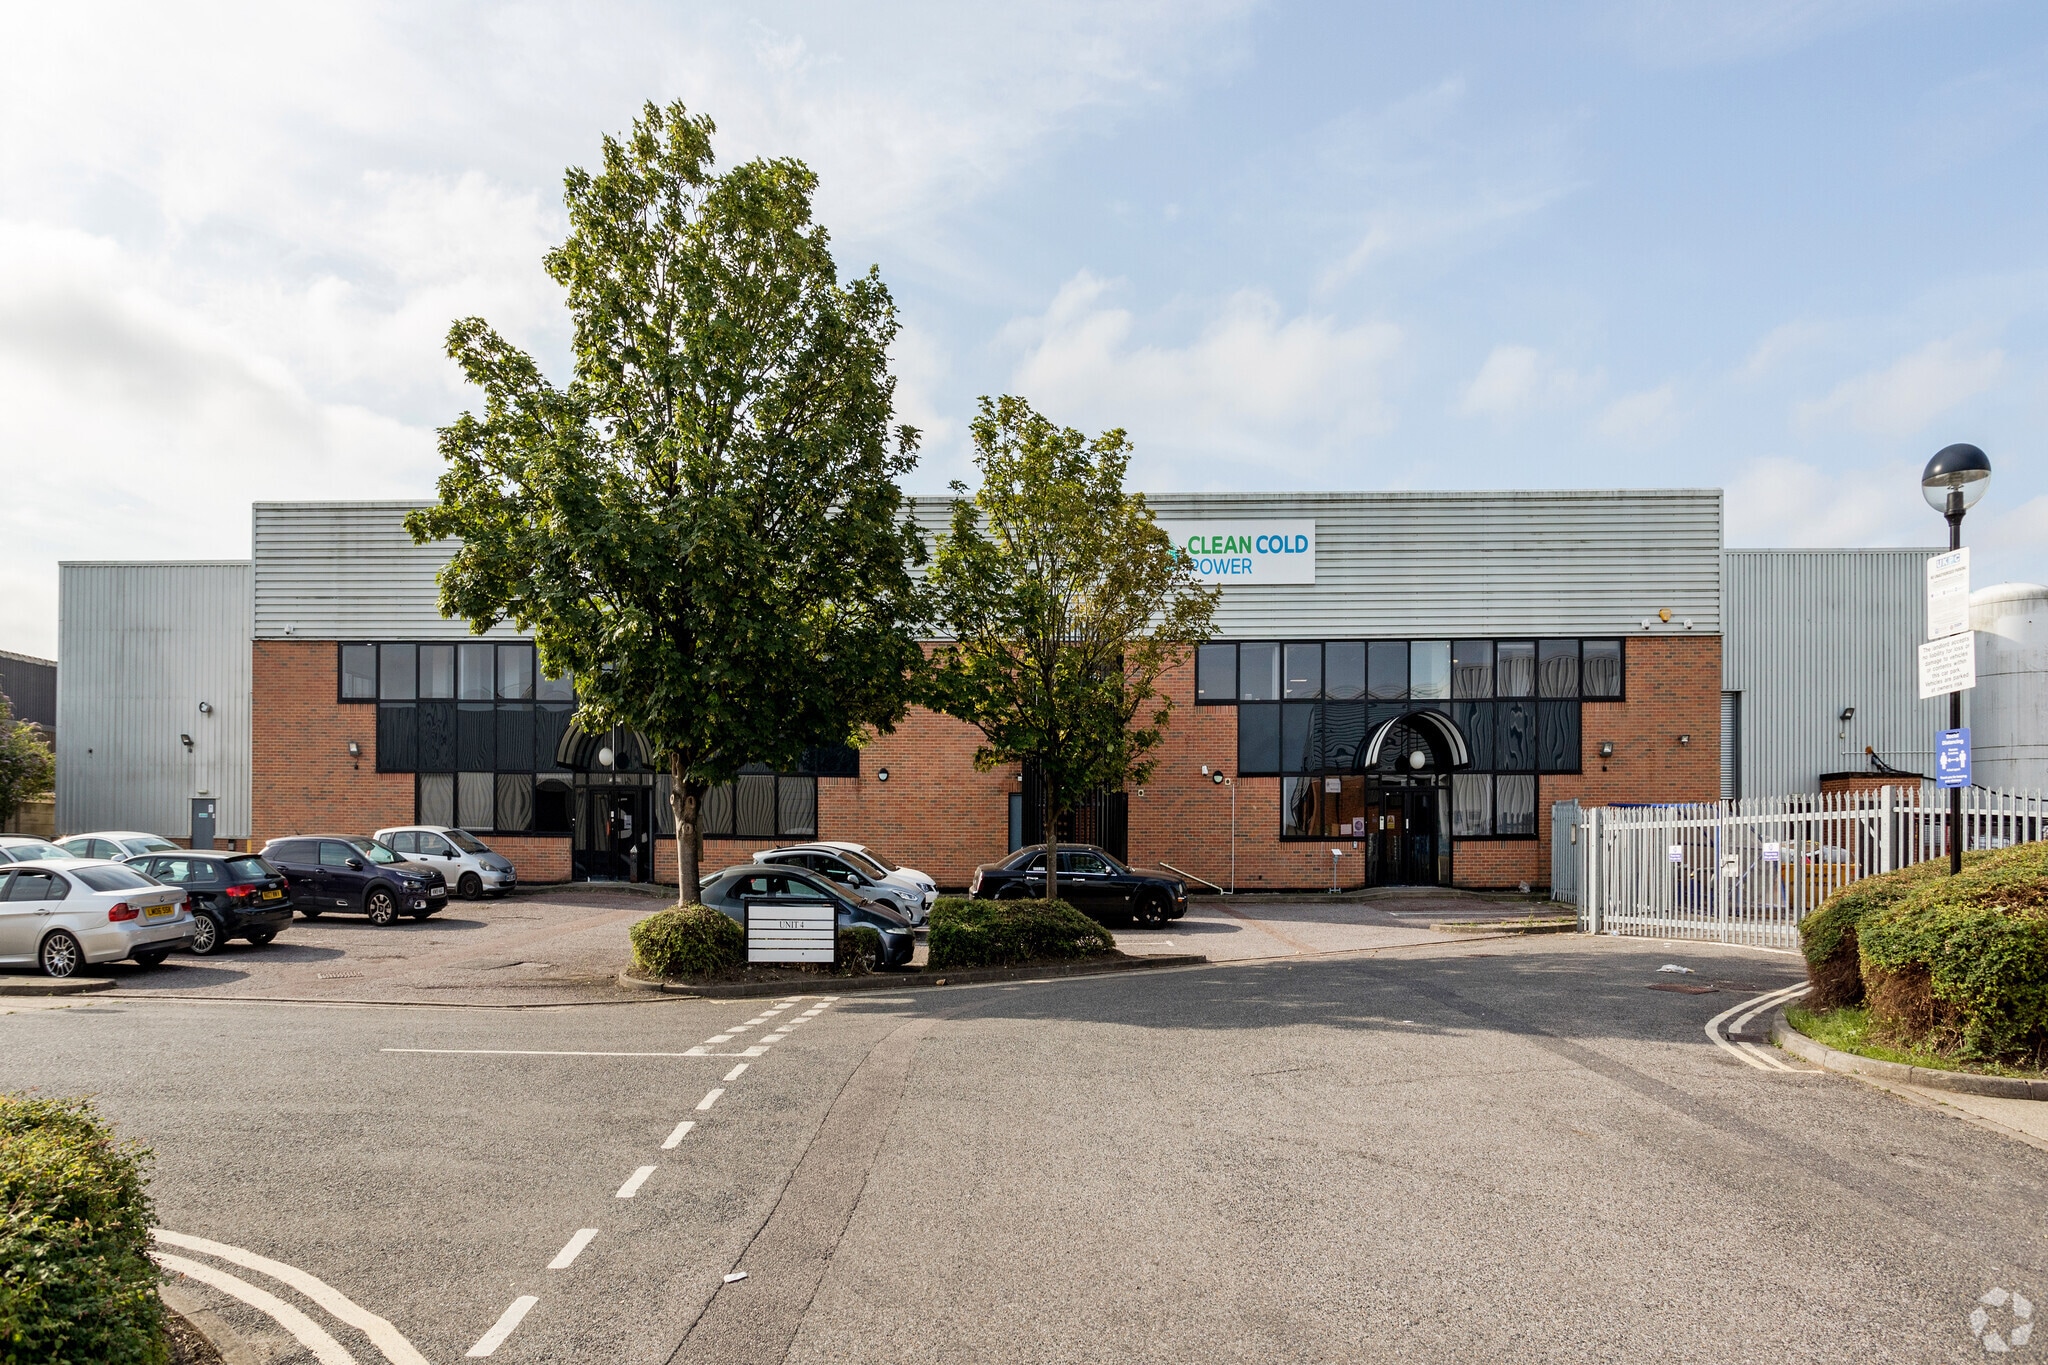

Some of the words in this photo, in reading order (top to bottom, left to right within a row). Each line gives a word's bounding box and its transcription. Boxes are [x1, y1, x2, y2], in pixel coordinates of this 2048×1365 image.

[1187, 535, 1252, 554] CLEAN
[1255, 535, 1309, 554] COLD
[1189, 558, 1253, 575] POWER
